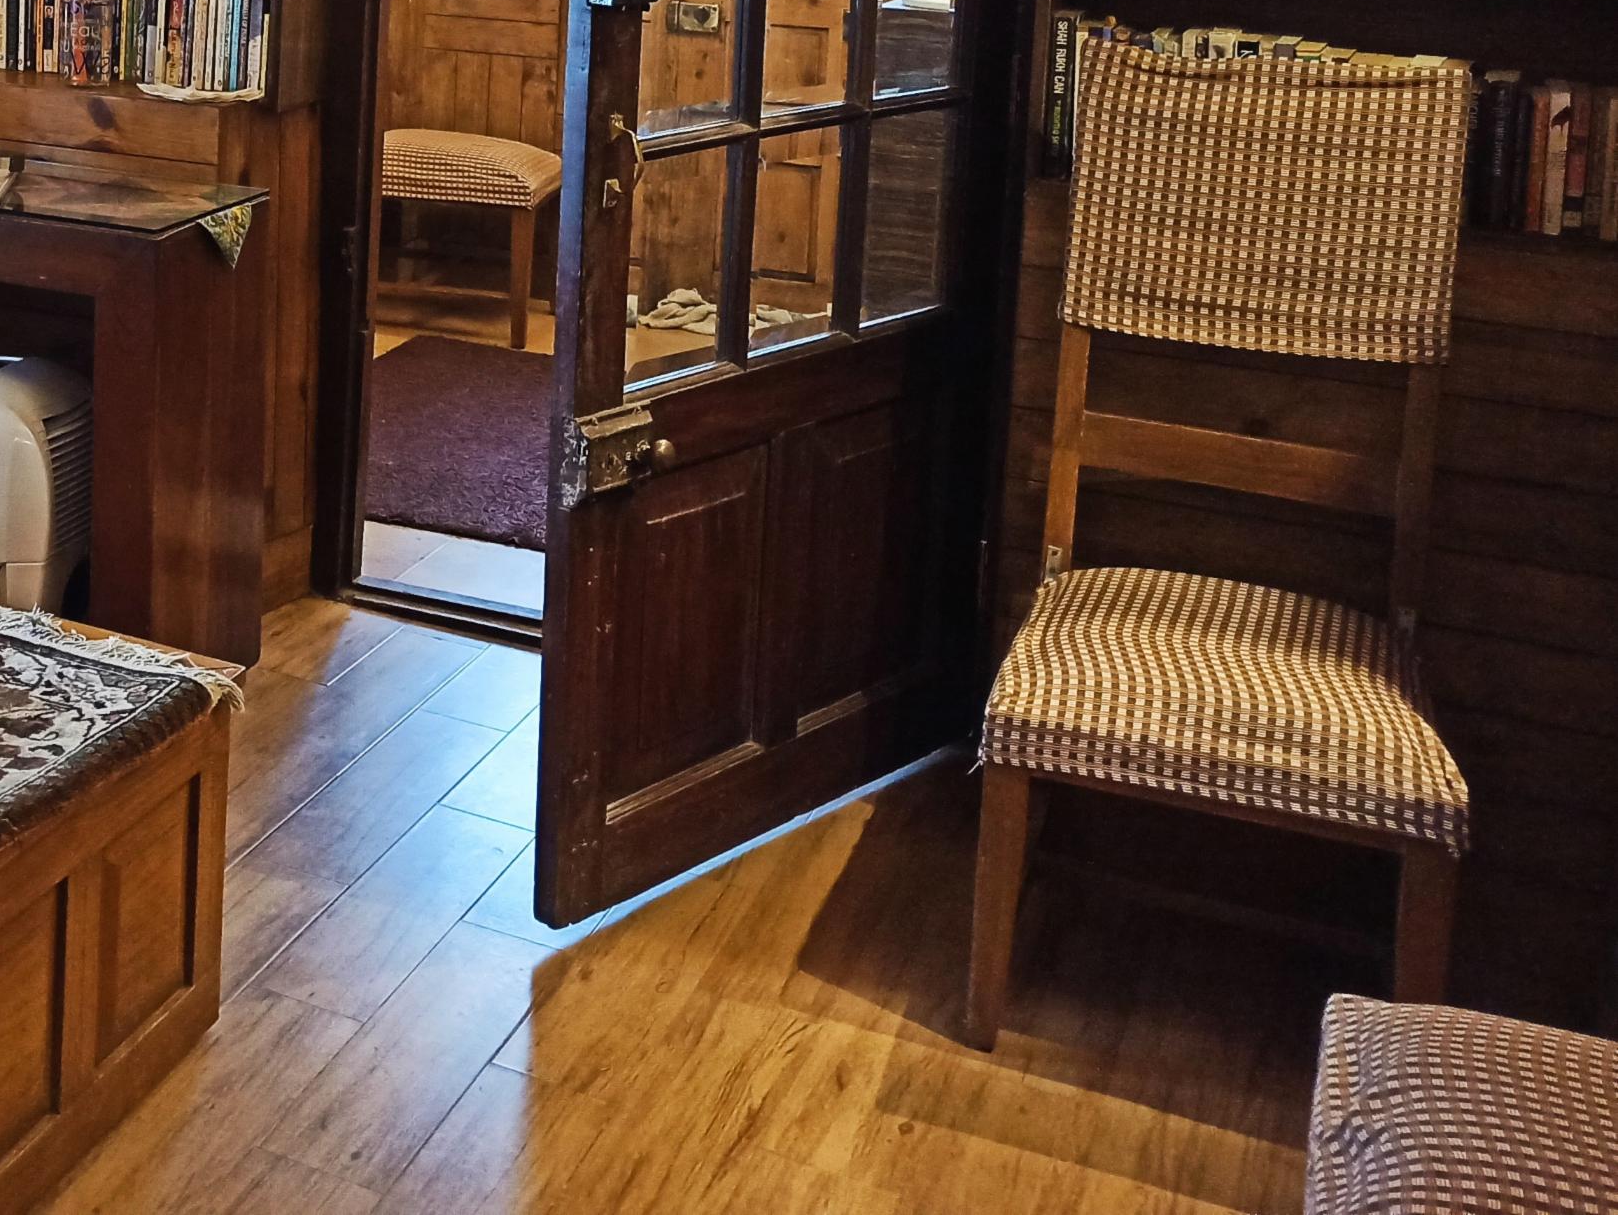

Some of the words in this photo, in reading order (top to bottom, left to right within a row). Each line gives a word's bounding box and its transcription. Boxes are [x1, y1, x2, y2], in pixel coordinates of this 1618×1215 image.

[1056, 21, 1069, 45] SHAH
[1055, 48, 1067, 72] RUKH
[1053, 75, 1065, 94] CAN
